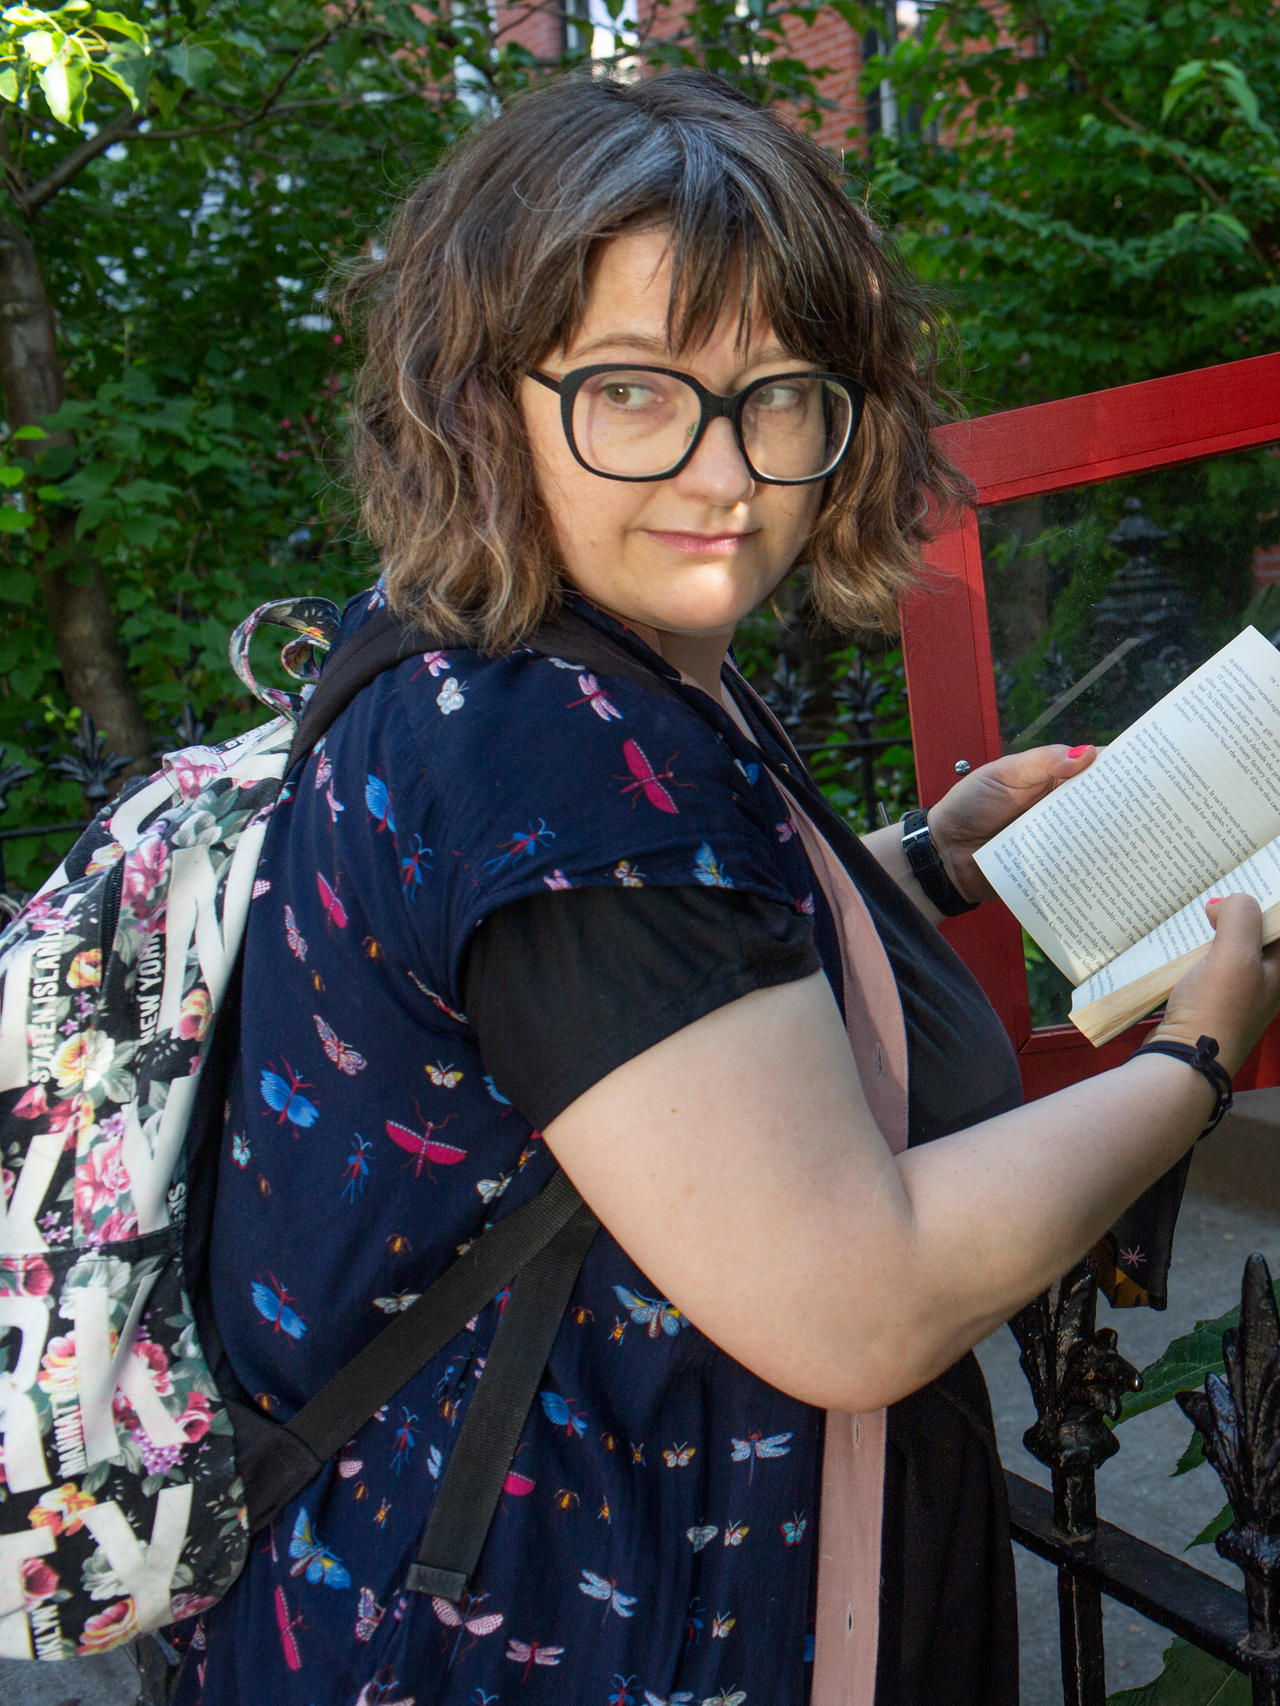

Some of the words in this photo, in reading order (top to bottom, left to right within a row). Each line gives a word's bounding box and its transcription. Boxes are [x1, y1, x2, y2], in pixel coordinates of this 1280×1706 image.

[32, 927, 65, 1005] ISLAND
[29, 1012, 58, 1084] STATEN
[136, 994, 161, 1047] NEW
